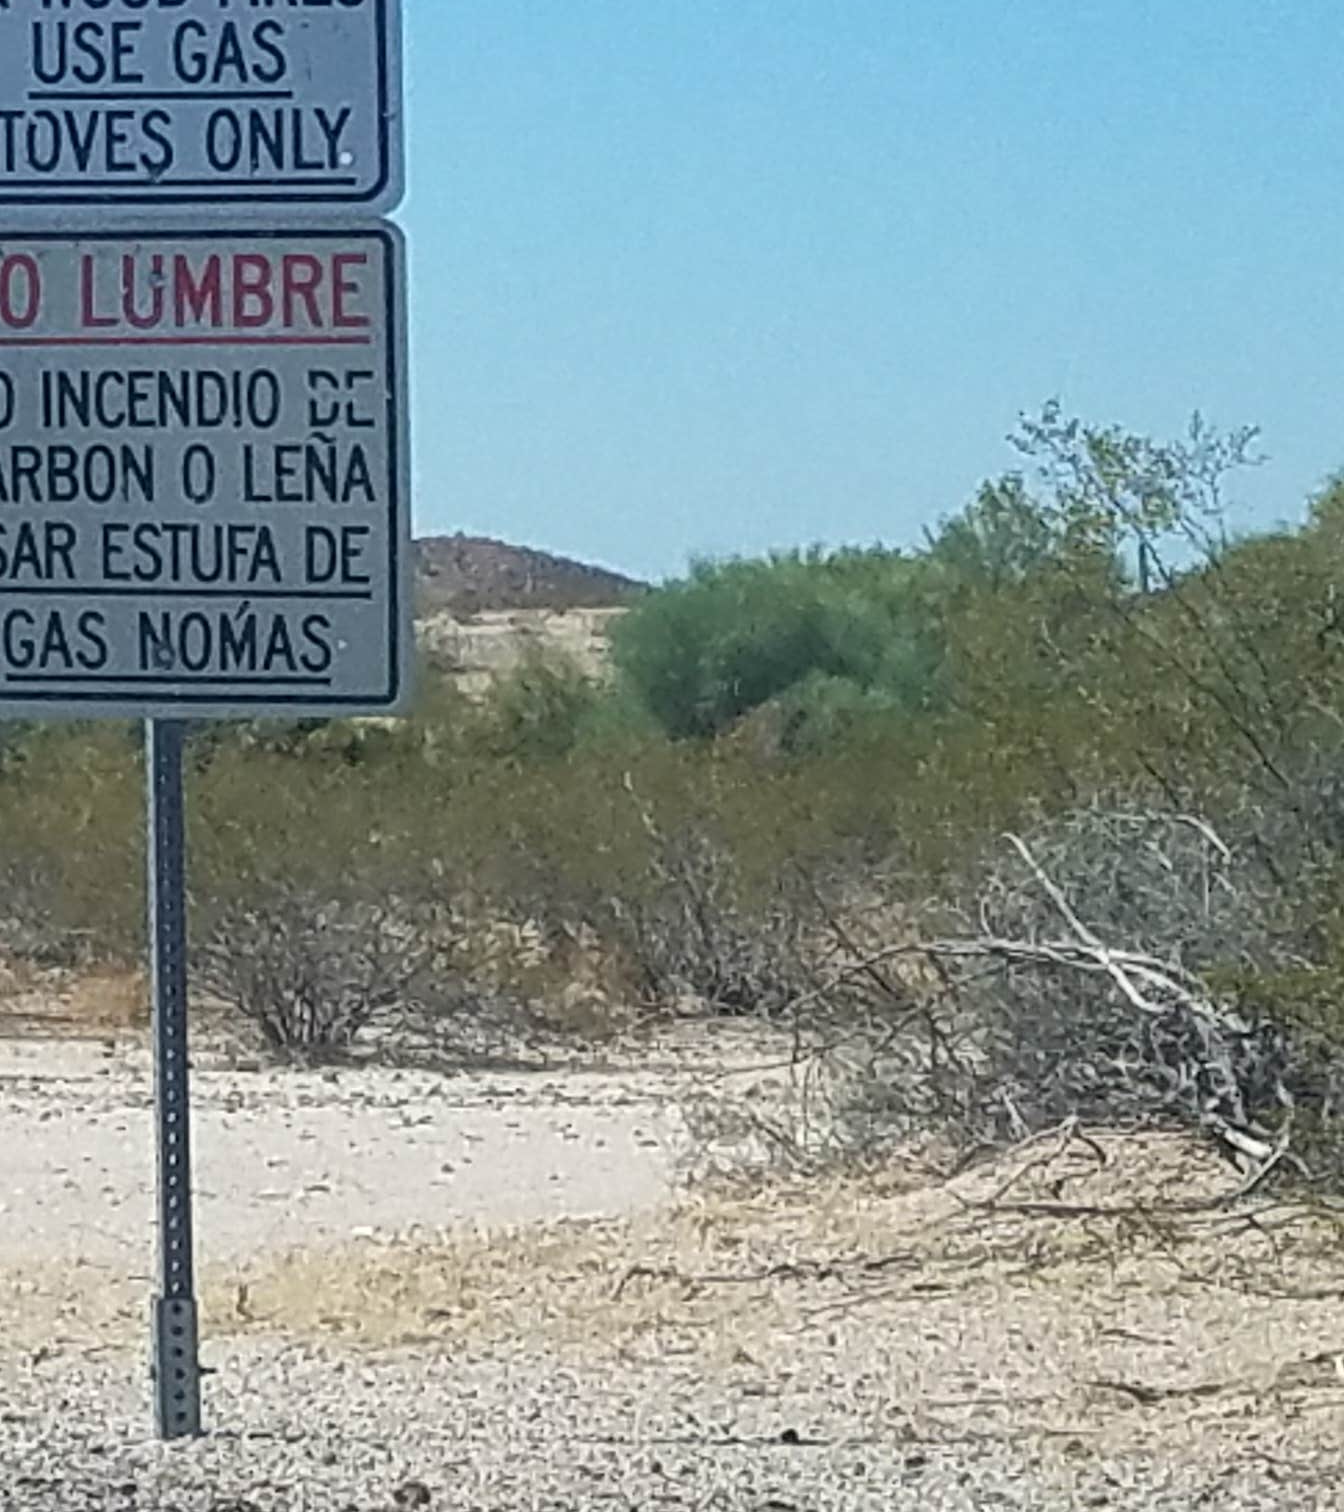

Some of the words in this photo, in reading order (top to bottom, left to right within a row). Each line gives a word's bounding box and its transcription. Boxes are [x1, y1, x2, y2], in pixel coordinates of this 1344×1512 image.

[31, 21, 144, 85] USE
[172, 20, 287, 85] GAS
[205, 107, 351, 171] ONLY
[81, 253, 372, 329] LUMBRE
[42, 368, 280, 430] INCENDIO
[307, 370, 376, 428] DE
[182, 444, 213, 506] O
[244, 432, 376, 504] LEÑA
[102, 523, 282, 584] ESTUFA
[305, 526, 371, 586] DE
[3, 610, 108, 671] GAS
